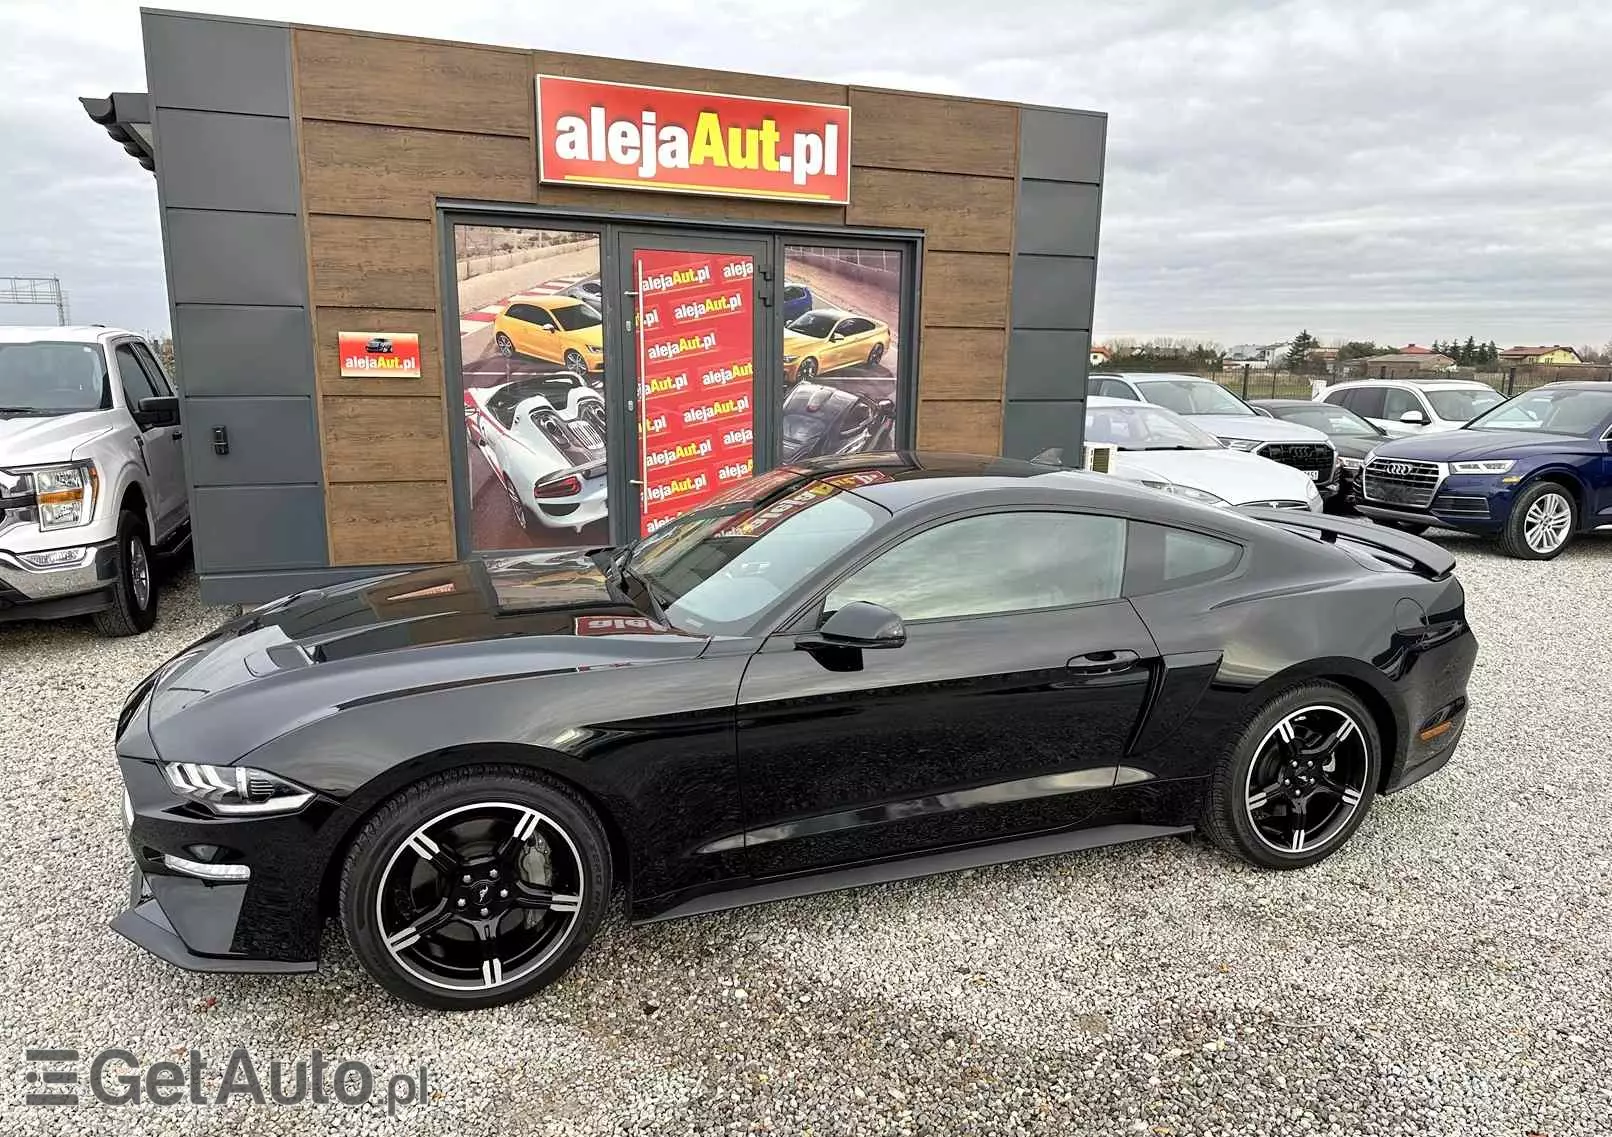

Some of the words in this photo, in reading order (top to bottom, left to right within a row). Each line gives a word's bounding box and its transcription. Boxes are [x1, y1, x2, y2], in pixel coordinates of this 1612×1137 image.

[555, 106, 838, 185] alejaAut.pl
[642, 265, 711, 291] alejaAut.pl
[674, 293, 742, 318] alejaAut.pl
[648, 333, 716, 359] alejaAut.pl
[345, 356, 415, 371] alejaAut.pl
[683, 396, 749, 422] alejaAut.pl
[646, 439, 712, 466] alejaAut.pl
